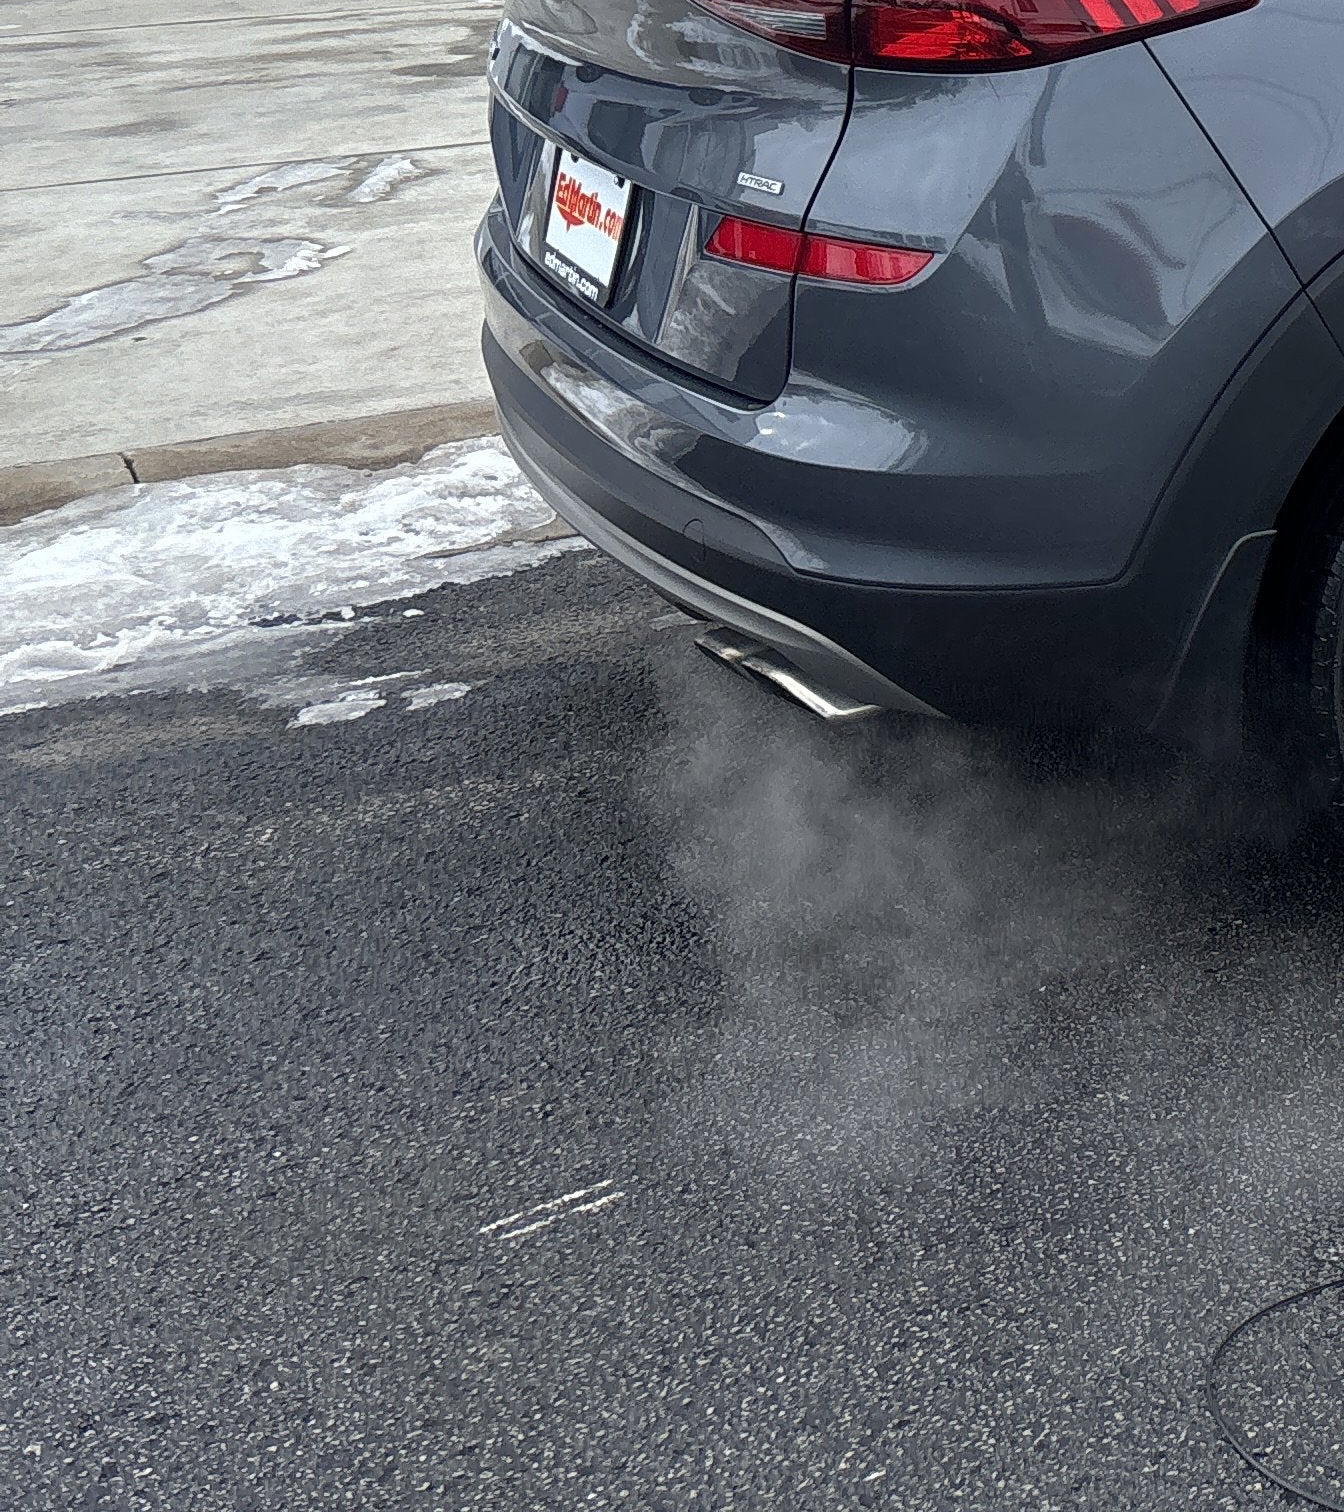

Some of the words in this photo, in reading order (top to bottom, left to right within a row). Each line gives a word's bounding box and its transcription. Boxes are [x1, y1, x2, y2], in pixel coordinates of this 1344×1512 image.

[555, 172, 624, 241] EdMartin.com
[740, 174, 778, 192] HTRAC
[544, 251, 599, 302] edmartin.com
